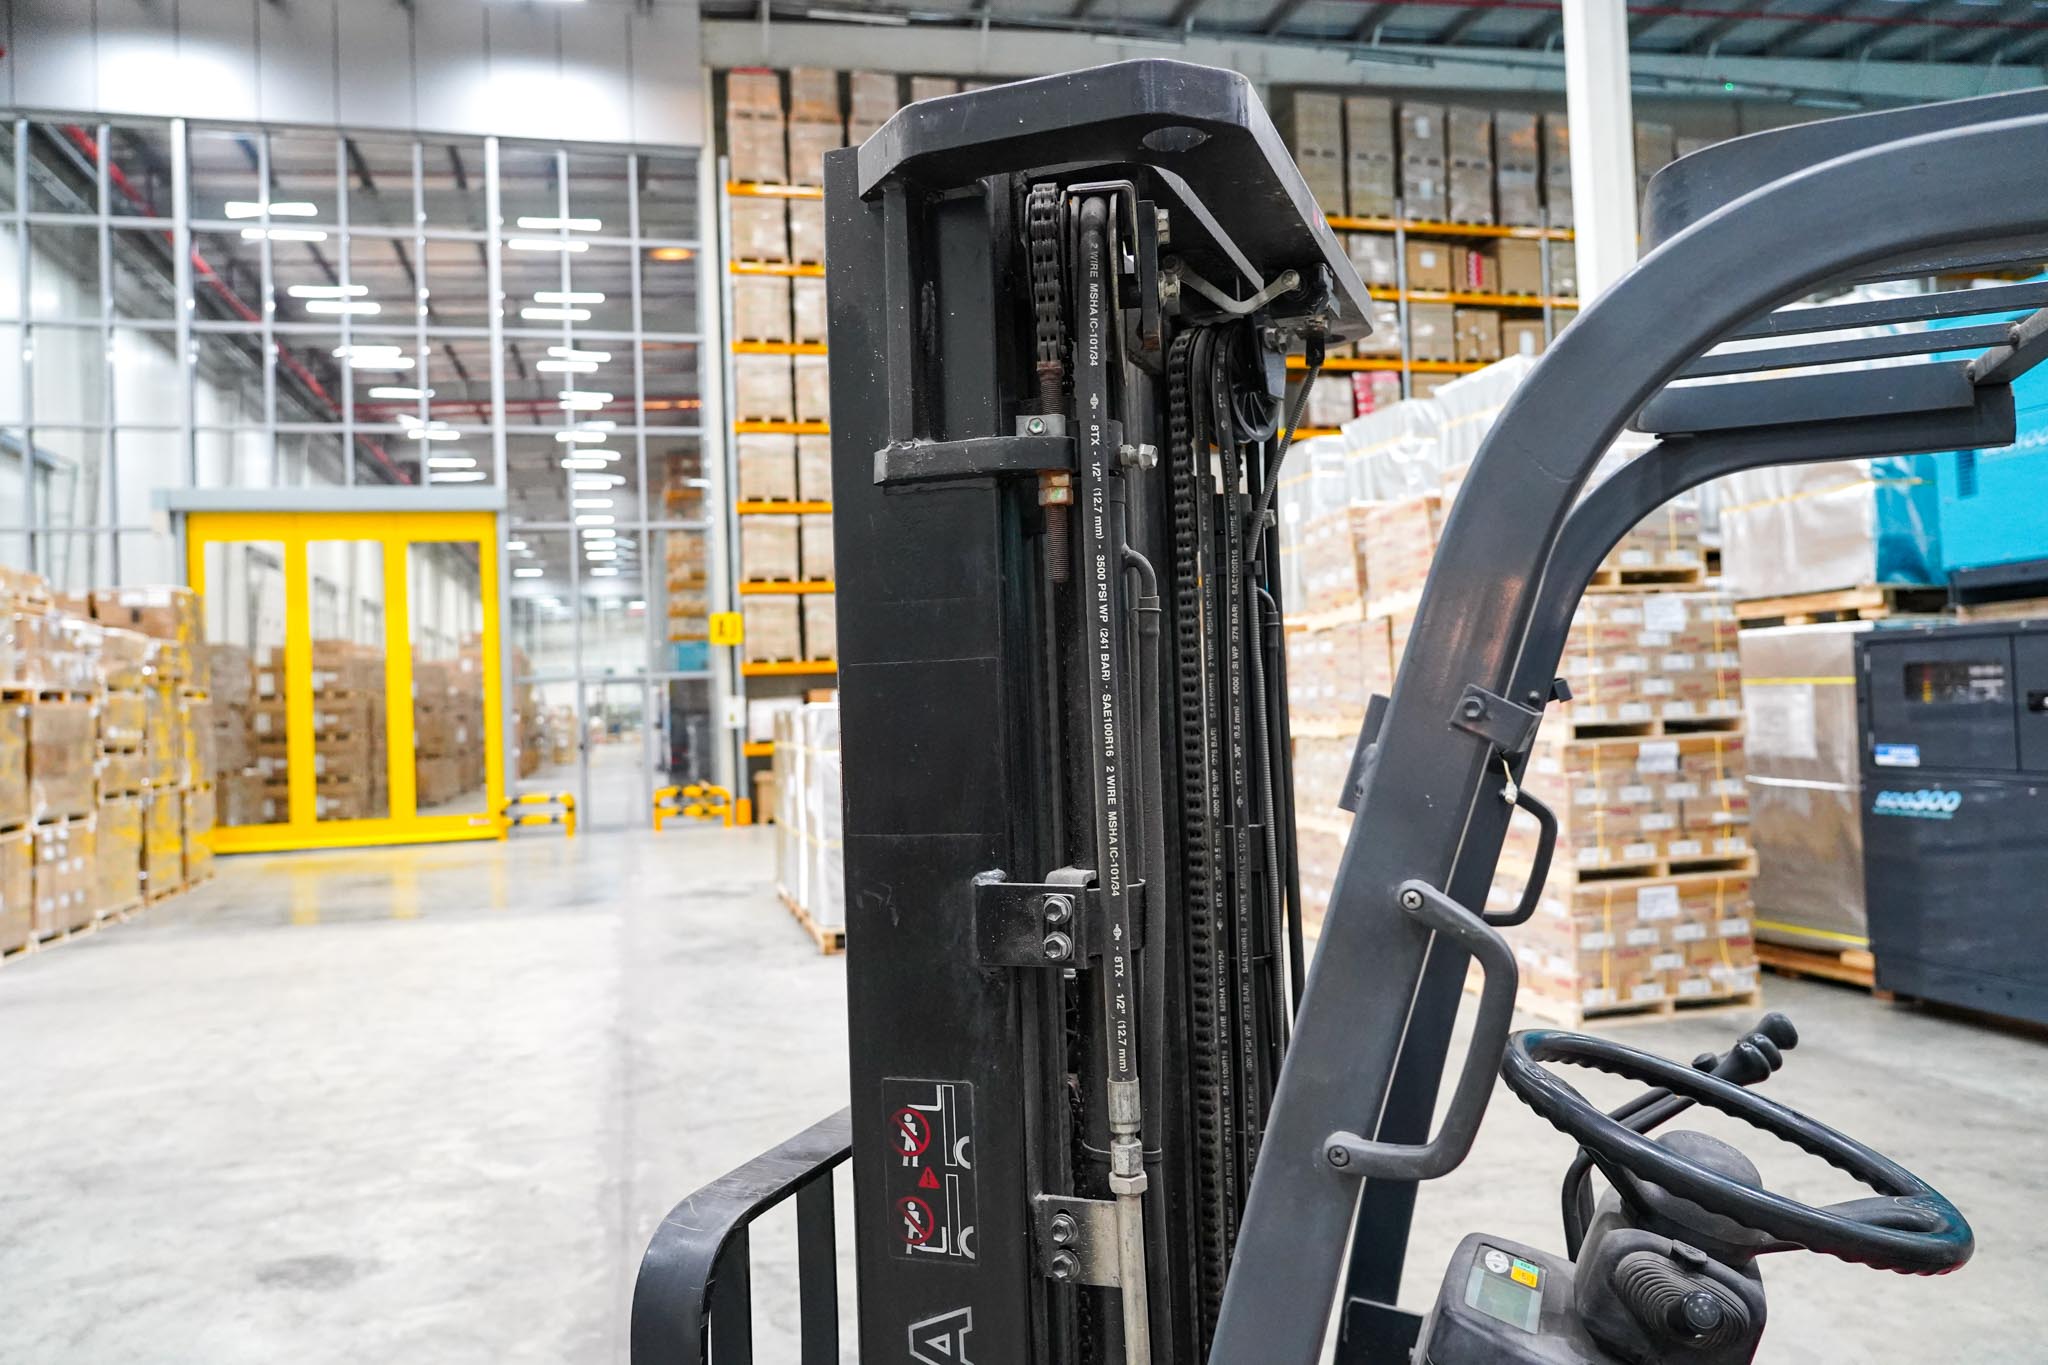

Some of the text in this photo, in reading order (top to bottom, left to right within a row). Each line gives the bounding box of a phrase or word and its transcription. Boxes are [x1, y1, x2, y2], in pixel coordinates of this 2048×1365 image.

[1089, 250, 1098, 277] WIRE
[1089, 283, 1098, 315] MSHA
[1089, 318, 1098, 366] IC-101/34
[1090, 424, 1100, 445] 8TX
[1091, 461, 1101, 481] 1/2"
[1092, 487, 1103, 513] (12.7
[1093, 515, 1104, 539] mm)
[1095, 554, 1106, 580] 3500
[1097, 583, 1107, 600] PSI
[1098, 604, 1108, 622] WP
[1231, 603, 1239, 624] BAR)
[1098, 627, 1109, 649] (241
[1231, 645, 1239, 659] WP
[1099, 653, 1111, 680] BAR)
[1231, 676, 1239, 695] 4000
[1101, 693, 1114, 756] SAE100R16
[1232, 705, 1240, 723] mm)
[1105, 775, 1116, 805] WIRE
[1107, 811, 1118, 844] MSHA
[1108, 847, 1120, 896] IC-101/34
[1113, 955, 1123, 977] 8TX
[1115, 993, 1125, 1013] 1/2"
[1116, 1020, 1127, 1045] (12.7
[1117, 1048, 1128, 1071] mm)
[1220, 1050, 1230, 1095] SAE100R1
[1223, 1106, 1231, 1125] BAR
